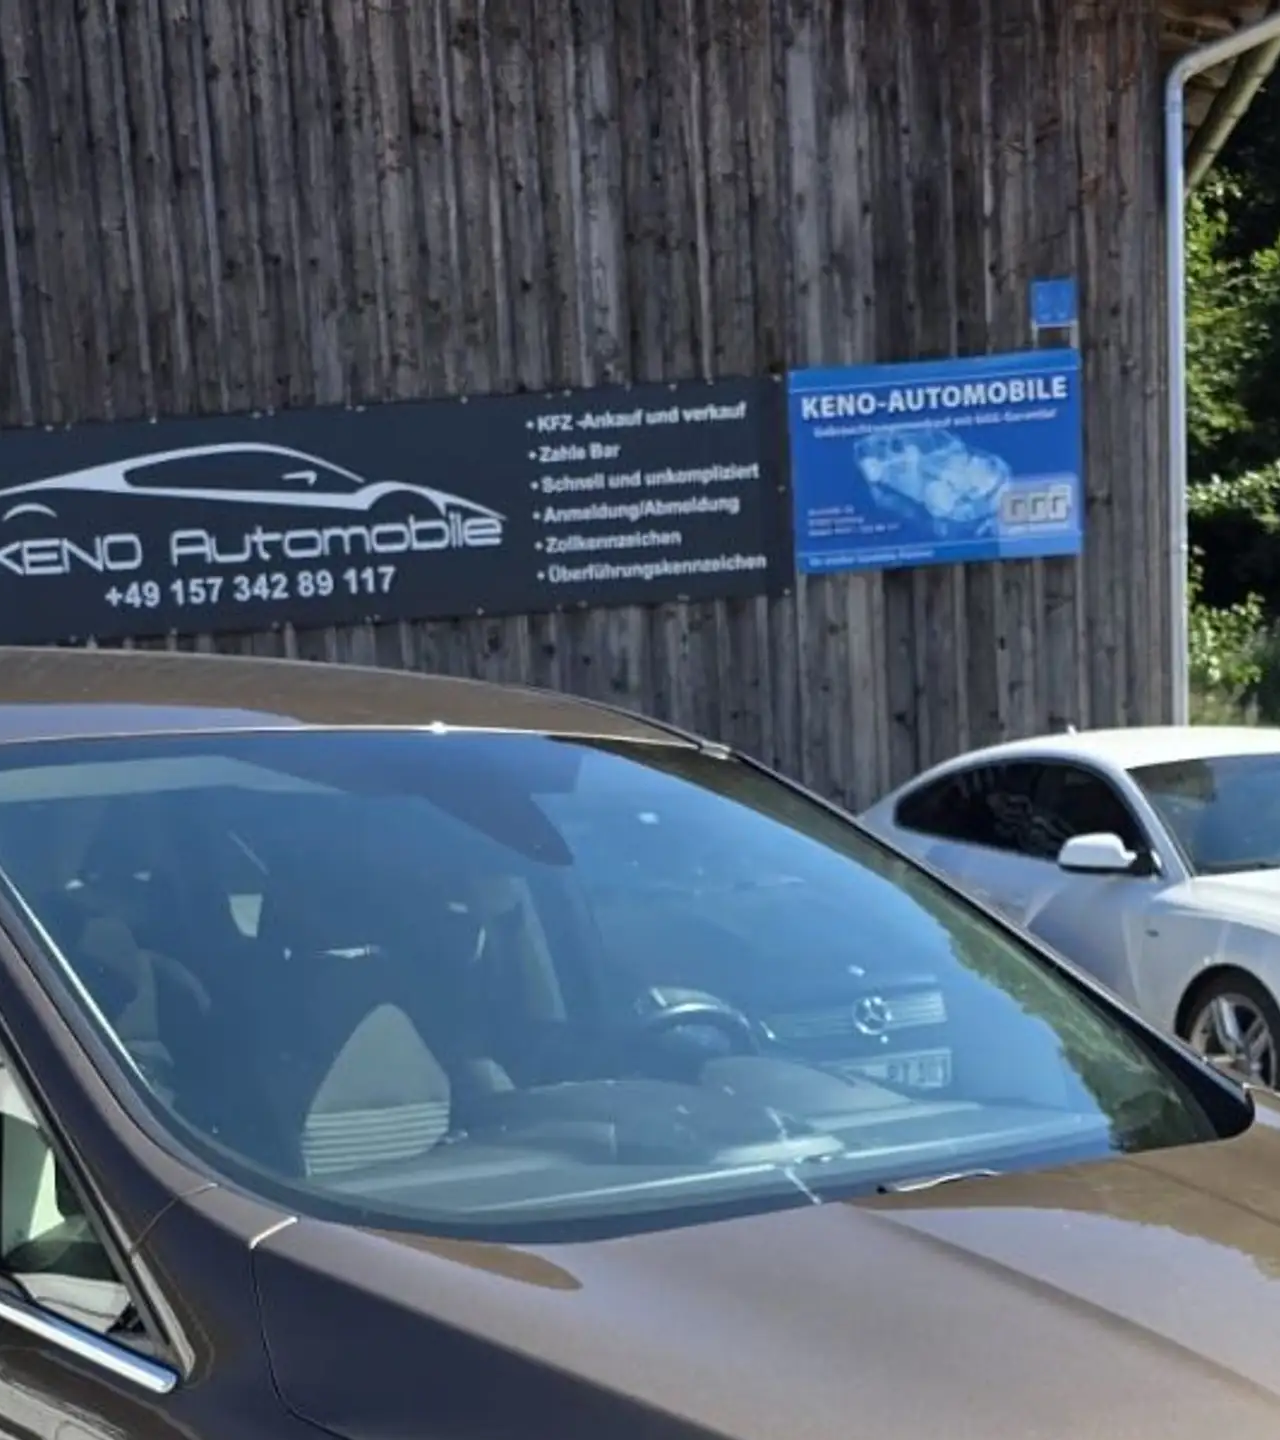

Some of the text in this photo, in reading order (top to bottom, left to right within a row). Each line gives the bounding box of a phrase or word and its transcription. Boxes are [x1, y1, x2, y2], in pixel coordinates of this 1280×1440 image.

[801, 376, 1068, 421] KENO-AUTOMOBILE
[537, 414, 573, 432] KFZ
[646, 406, 680, 424] und
[539, 441, 620, 463] Zahle Bar
[541, 463, 760, 493] Schnell und unkompliziert
[170, 514, 502, 566] Automobile
[545, 531, 682, 554] Zollkennzeichen
[105, 566, 396, 607] +49 157 342 89 117
